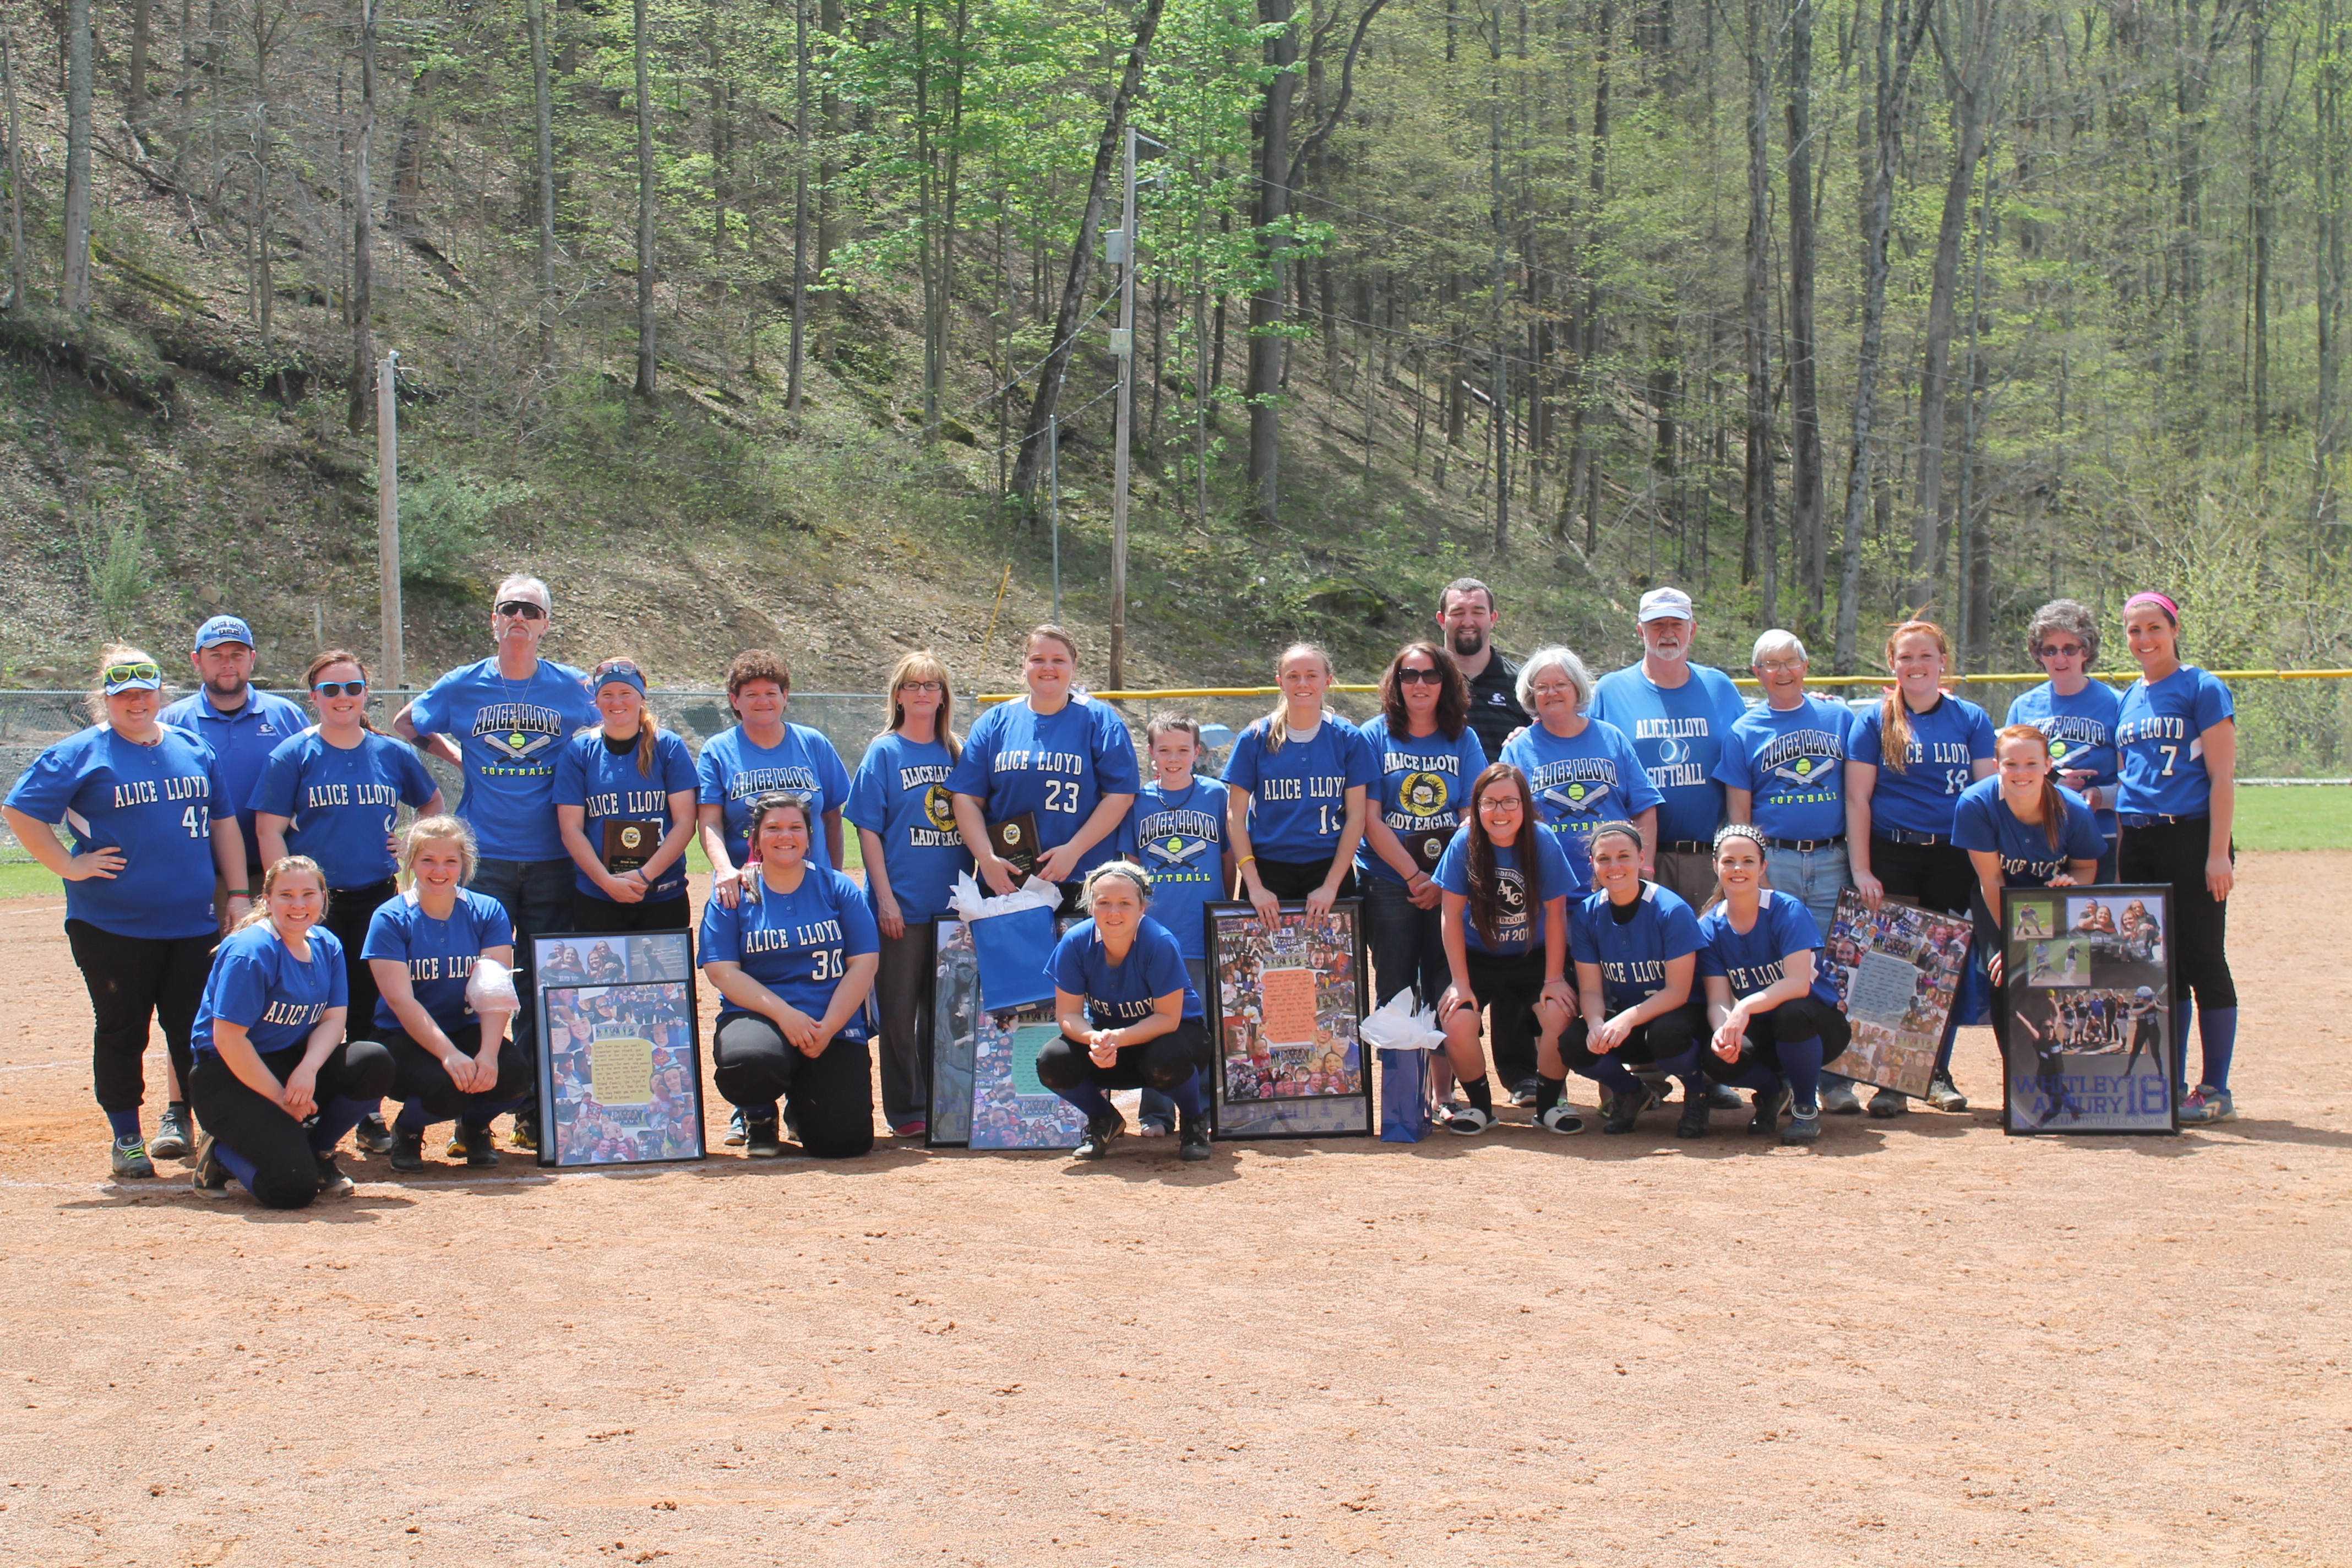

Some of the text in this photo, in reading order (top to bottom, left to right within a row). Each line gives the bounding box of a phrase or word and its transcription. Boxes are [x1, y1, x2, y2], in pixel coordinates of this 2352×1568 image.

[472, 703, 562, 737] ALICE LLOYD
[1636, 717, 1709, 739] ALICE LLOYD
[2060, 716, 2105, 747] LLOYD
[2115, 716, 2184, 748] ICE LLOYD
[994, 750, 1082, 775] ALICE LLOYD
[1761, 731, 1801, 773] ALICE
[1800, 729, 1843, 761] LLOYD
[2159, 745, 2177, 776] 7
[481, 765, 553, 776] SOFTBALL
[1383, 752, 1460, 777] ALICE LLOYD
[1530, 757, 1619, 794] ALICE LLOYD
[1646, 763, 1706, 788] SOFTBALL
[731, 768, 775, 801] ALICE
[900, 765, 954, 791] ALICE LLO
[1264, 778, 1302, 801] ALICE
[115, 776, 210, 808] ALICE LLOYD
[308, 784, 396, 808] ALICE LLOYD
[586, 790, 666, 818] ALICE LLOYD
[1045, 779, 1080, 814] 23
[1770, 791, 1838, 805] SOFTBALL
[182, 805, 210, 838] 42
[1139, 809, 1219, 850] ALICE LLOYD
[1385, 811, 1457, 831] LADY EAGLES
[1551, 820, 1611, 833] OFTBA
[909, 827, 966, 846] LADY EAG
[1495, 870, 1524, 884] EADERSHIP
[2000, 853, 2027, 875] LICE
[1148, 873, 1211, 883] OFTBALL
[1496, 879, 1523, 906] ALC
[1507, 915, 1527, 923] COLL
[746, 919, 842, 953] ALICE LLOYD
[1499, 930, 1510, 942] of
[1511, 928, 1529, 941] 201
[409, 955, 479, 981] LICE LLO
[811, 948, 843, 981] 30
[1600, 960, 1665, 983] LICE LLOY
[1750, 960, 1785, 986] LLOY
[263, 1000, 309, 1026] ALICE
[1085, 992, 1154, 1018] LICE LLOY
[2012, 1074, 2170, 1116] WHITLEY 18
